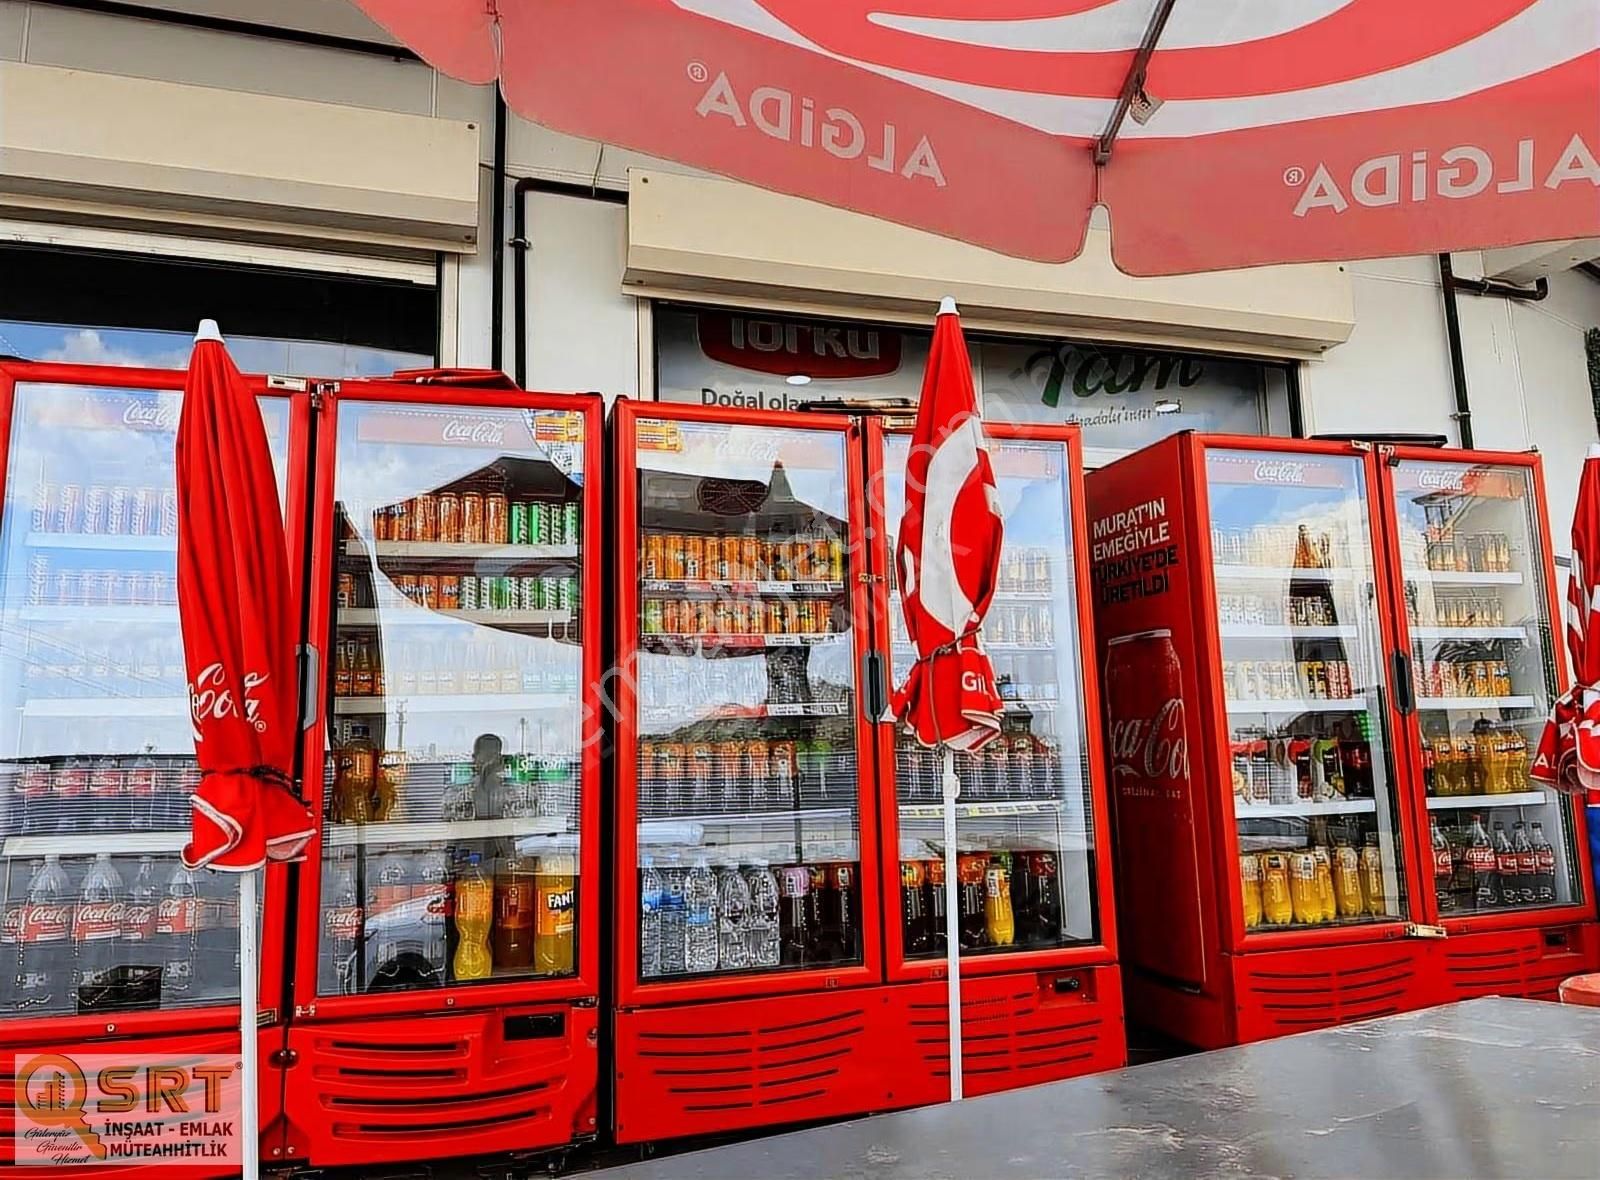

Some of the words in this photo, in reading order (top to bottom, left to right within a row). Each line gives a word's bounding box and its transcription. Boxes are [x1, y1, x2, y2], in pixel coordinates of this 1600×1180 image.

[701, 387, 765, 410] Doğal
[1093, 496, 1166, 540] MURAT'IN
[1092, 520, 1171, 563] EMEĞİYLE
[547, 889, 574, 908] FANT
